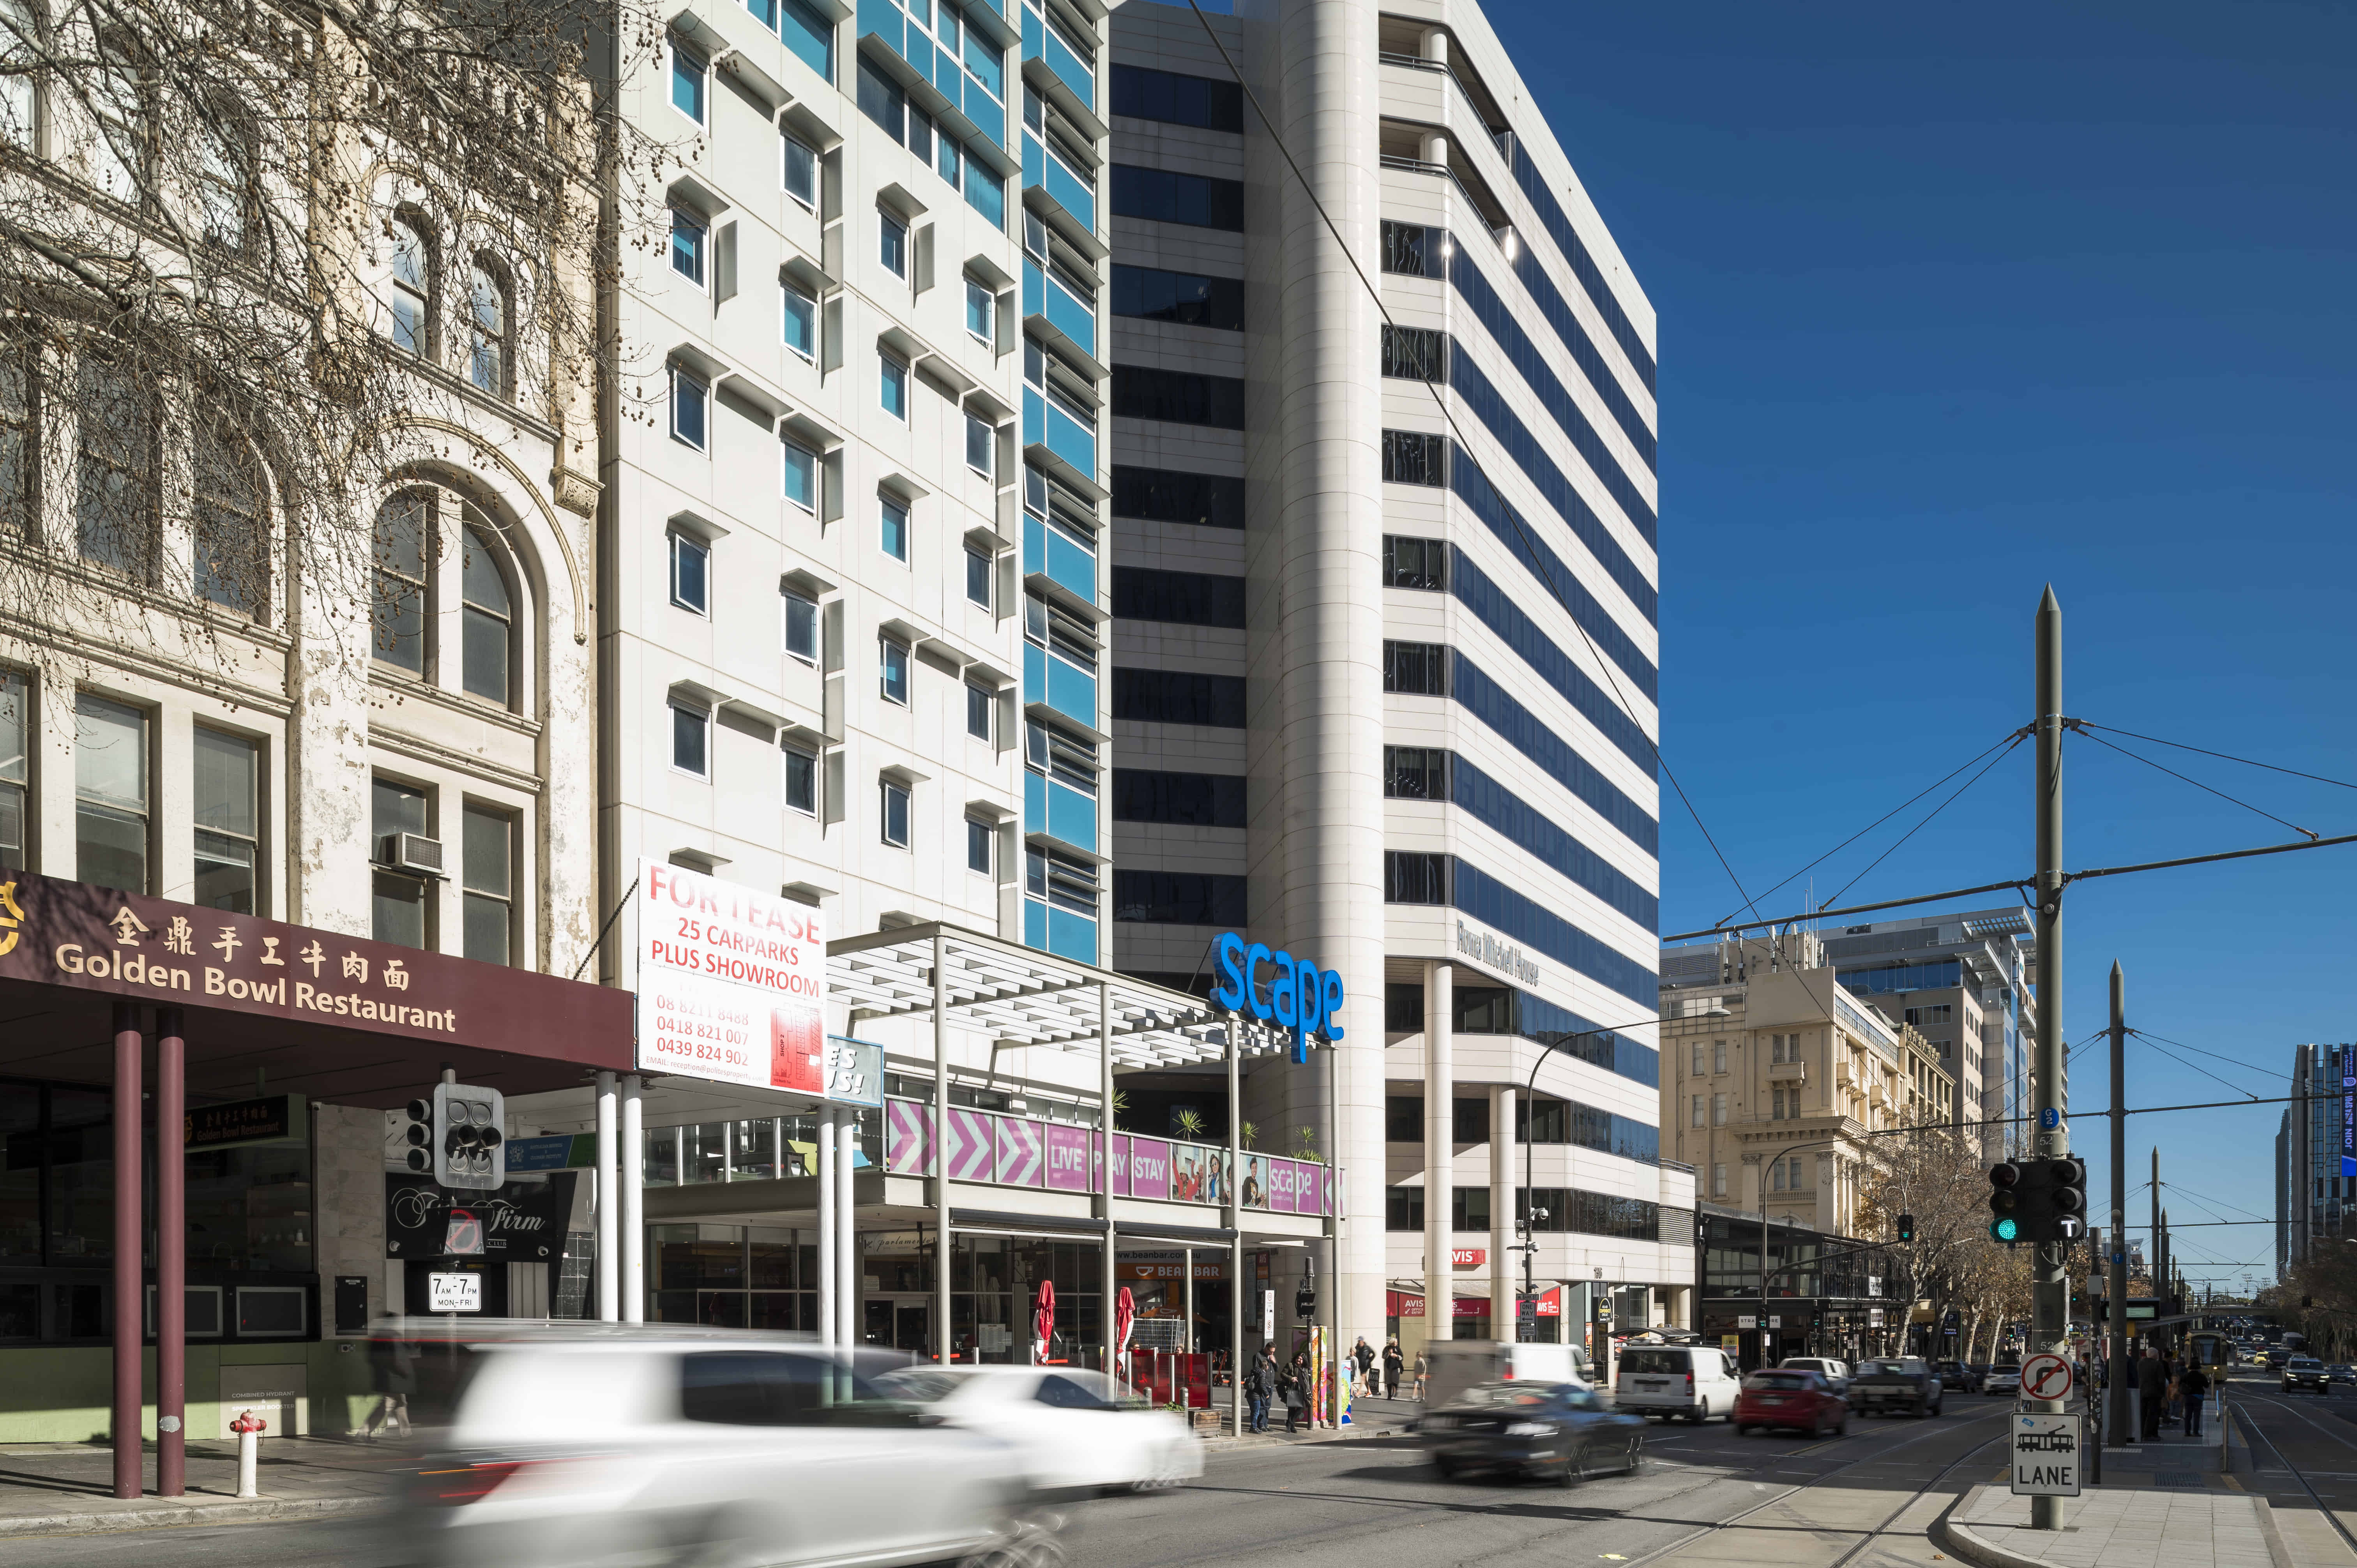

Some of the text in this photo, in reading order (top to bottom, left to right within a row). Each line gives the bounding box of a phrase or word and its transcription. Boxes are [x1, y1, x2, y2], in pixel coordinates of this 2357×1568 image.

[651, 865, 719, 917] FOR
[108, 906, 409, 991] 金鼎手工牛肉面
[678, 918, 798, 966] 25 CARPARKS
[1457, 919, 1539, 987] Roma Mitchell House
[652, 940, 700, 969] PLUS
[706, 953, 819, 998] SHOWROOM
[56, 943, 456, 1032] Golden Bowl Restaurant
[1210, 932, 1344, 1064] scape
[657, 994, 675, 1010] 08
[657, 1016, 748, 1045] 0418 821 007
[646, 1056, 669, 1066] EMAIL:
[657, 1037, 749, 1066] 0439 824 902
[196, 1120, 279, 1142] Golden Bowl Restaurant
[2039, 1135, 2053, 1145] 52
[2345, 1128, 2353, 1149] JOIN
[1051, 1144, 1082, 1171] LIVE
[1094, 1150, 1127, 1176] PAY
[1134, 1156, 1165, 1181] STAY
[1271, 1168, 1312, 1204] scape
[1283, 1195, 1293, 1203] Living
[471, 1199, 545, 1232] Firm
[1194, 1266, 1219, 1277] BAR
[1537, 1302, 1547, 1312] AVIS
[2040, 1341, 2055, 1351] 52
[2019, 1466, 2072, 1485] LANE
